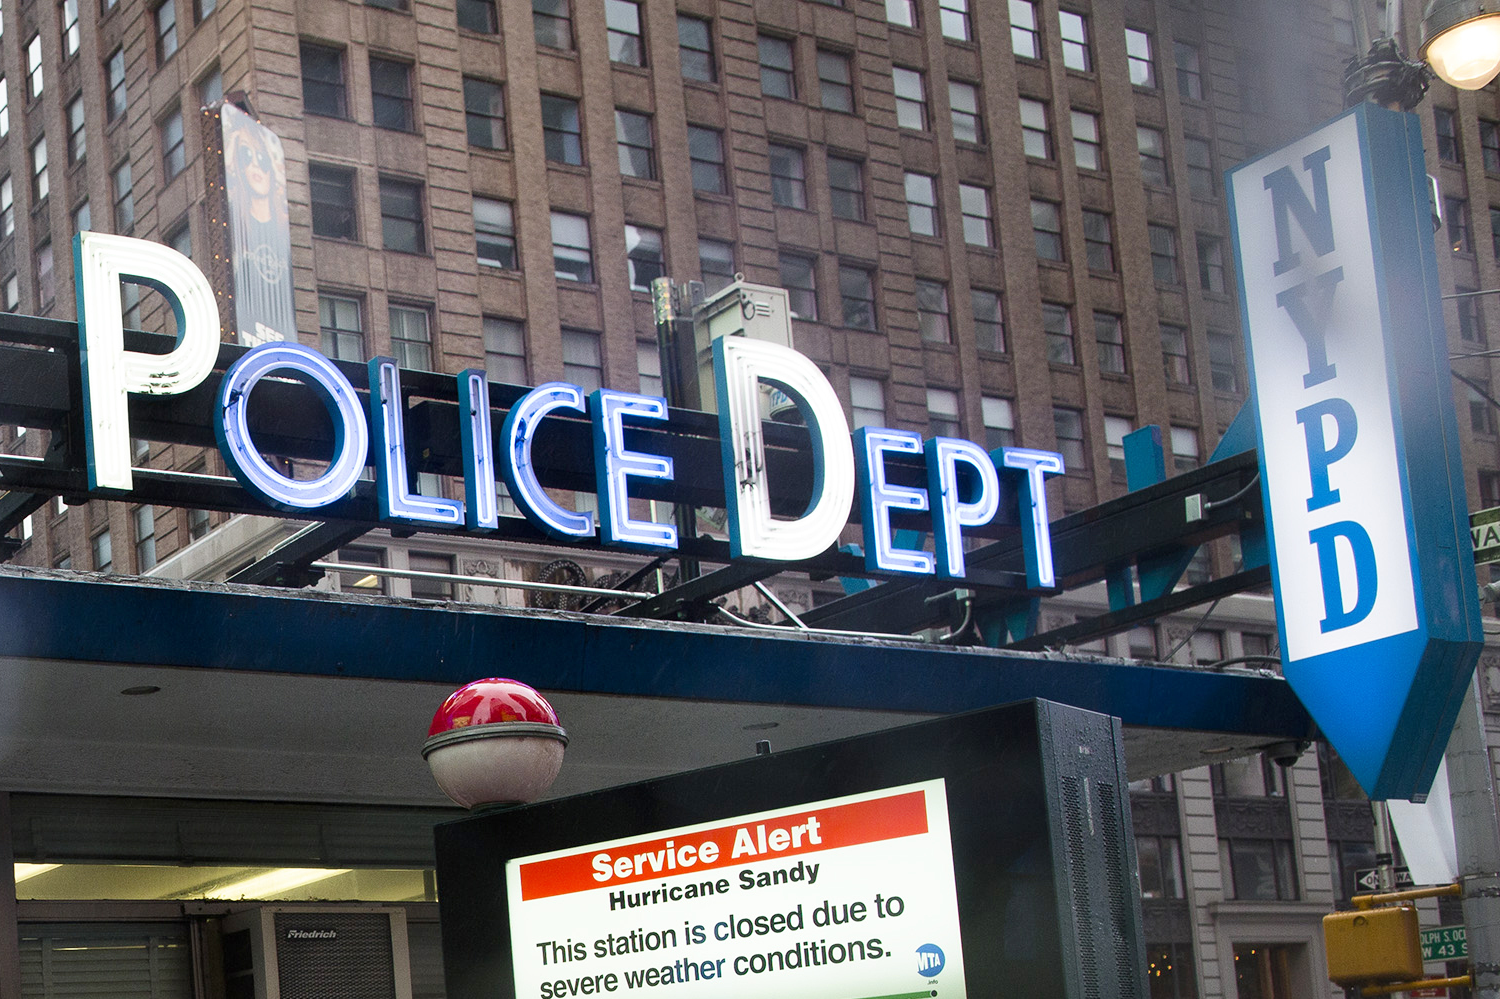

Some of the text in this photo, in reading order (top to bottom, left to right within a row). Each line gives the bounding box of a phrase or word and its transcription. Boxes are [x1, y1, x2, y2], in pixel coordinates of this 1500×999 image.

[1263, 146, 1379, 635] NYPD
[591, 816, 822, 882] Service Alert
[609, 861, 820, 911] Hurricane Sandy
[287, 929, 337, 939] Friedrich
[537, 892, 905, 966] This station is closed due to
[1438, 944, 1456, 956] 43
[540, 938, 892, 999] severe weather conditions.
[915, 949, 943, 974] MTA
